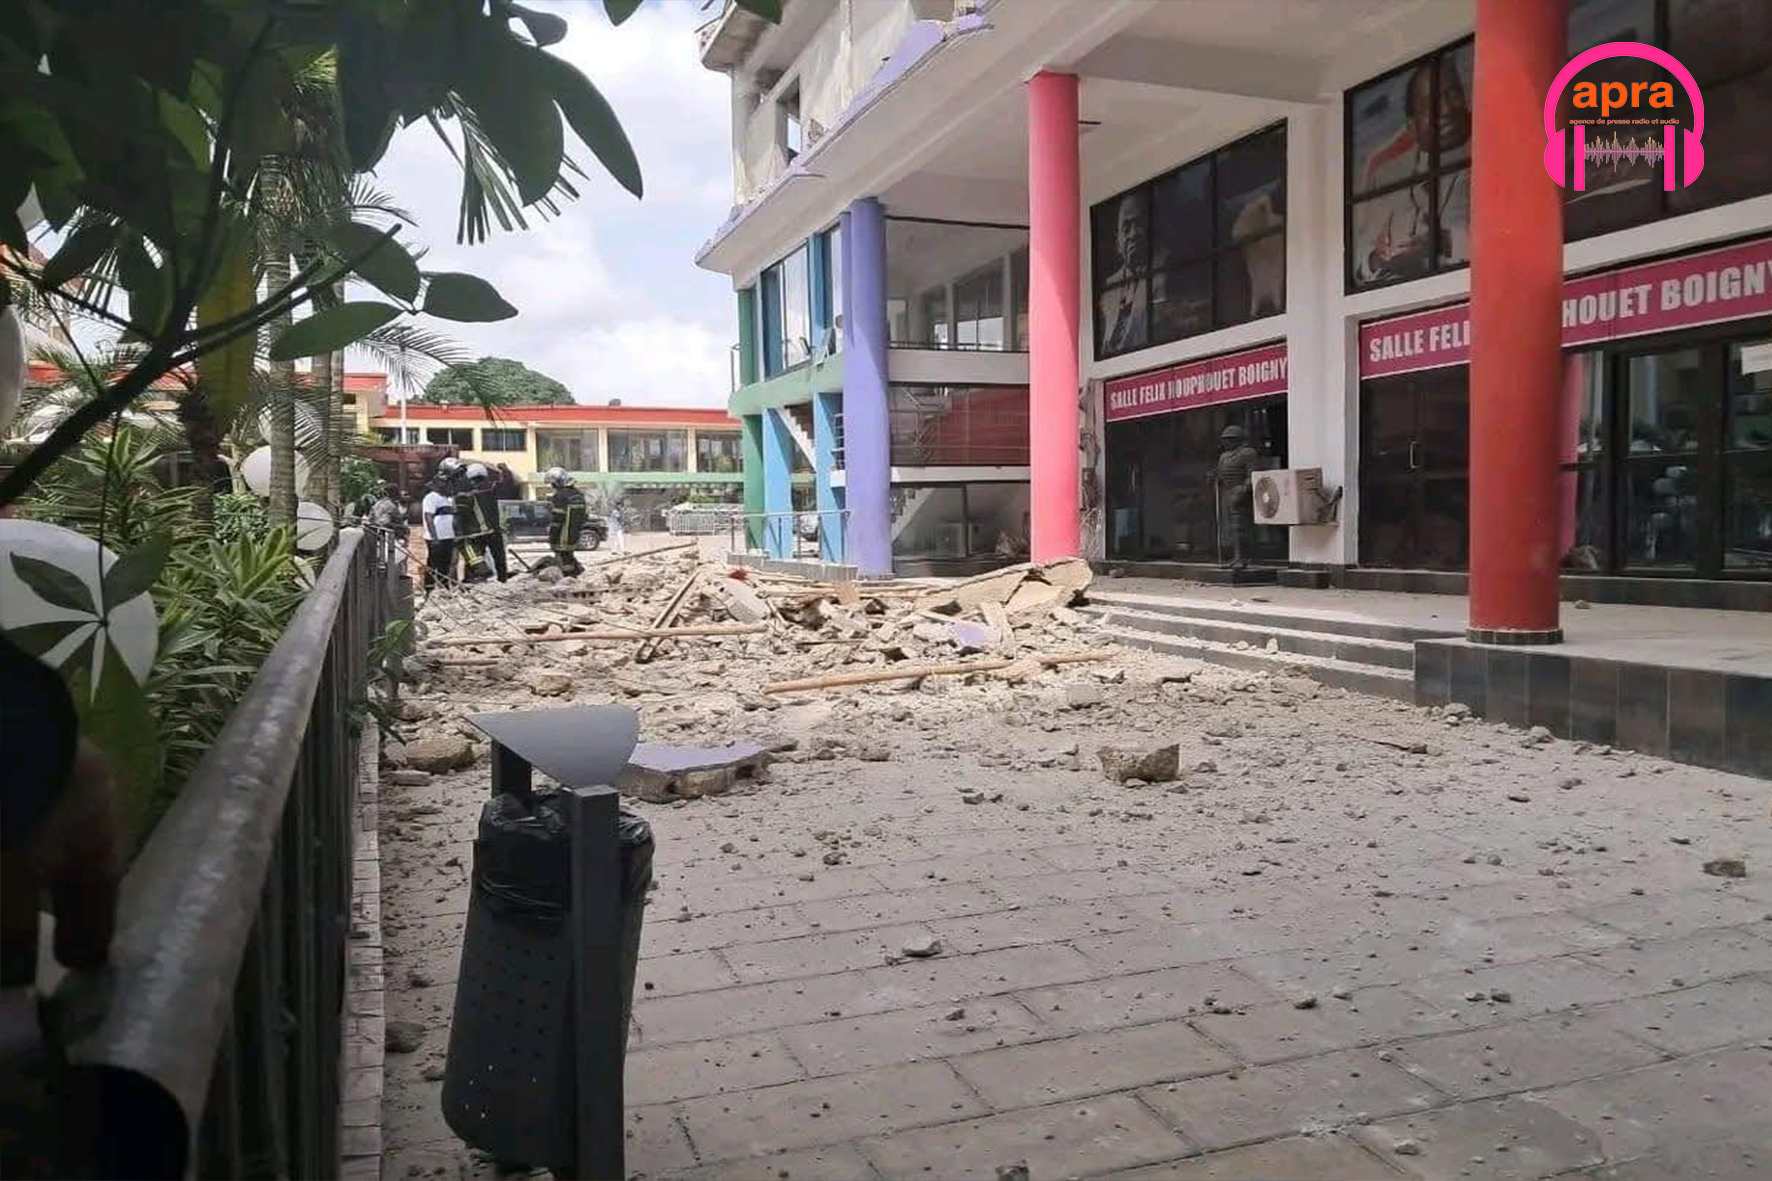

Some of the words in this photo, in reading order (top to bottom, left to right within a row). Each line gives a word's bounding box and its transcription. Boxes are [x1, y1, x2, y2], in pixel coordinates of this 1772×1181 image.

[1369, 329, 1425, 362] SALLE
[1429, 320, 1471, 352] FELI
[1562, 284, 1653, 329] HOUET
[1110, 388, 1138, 410] SALLE
[1140, 381, 1166, 405] FELIX
[1168, 368, 1236, 400] HOUPHOUET
[1238, 357, 1288, 388] BOIGNY
